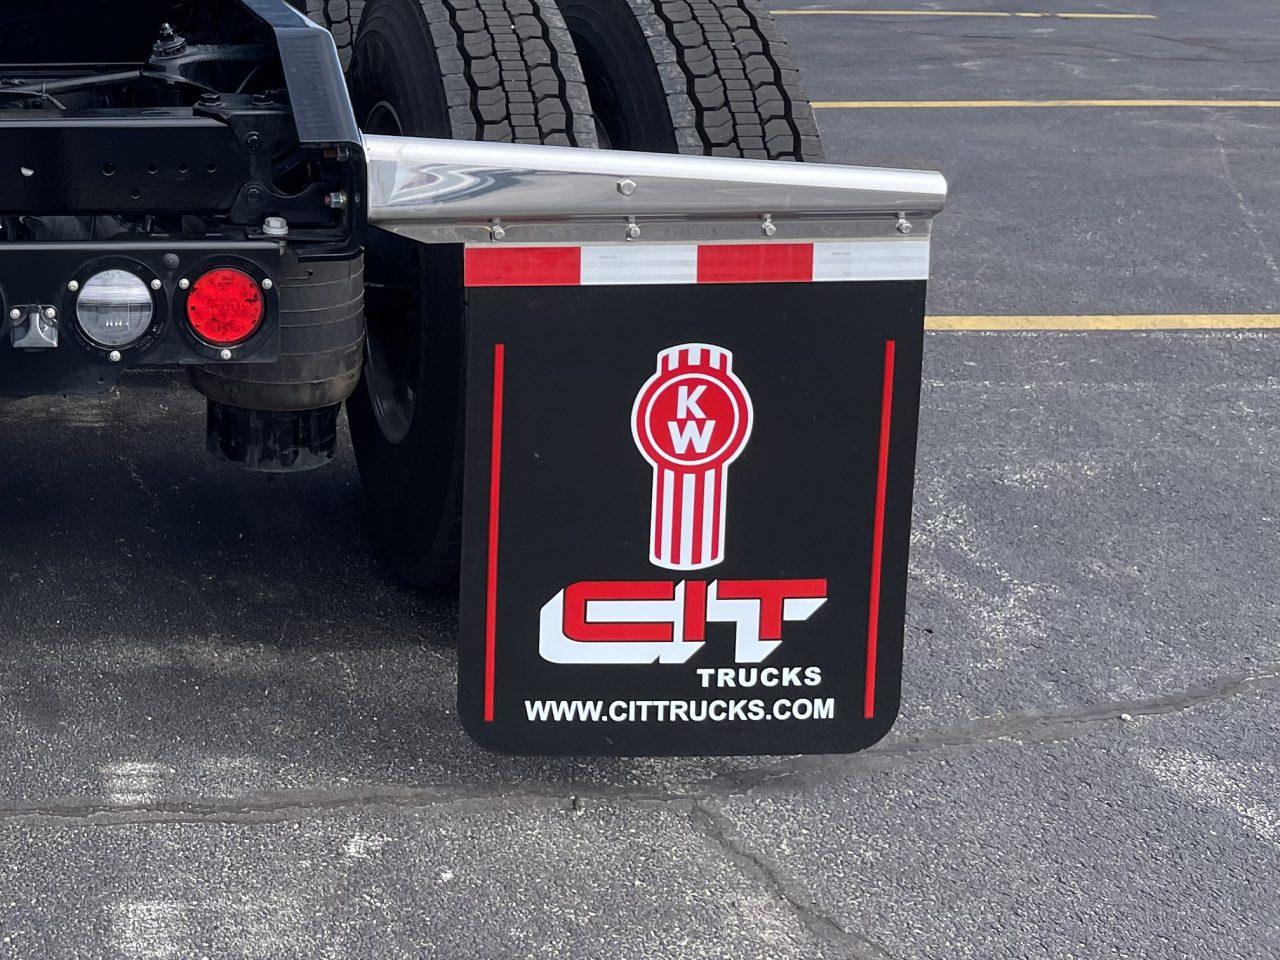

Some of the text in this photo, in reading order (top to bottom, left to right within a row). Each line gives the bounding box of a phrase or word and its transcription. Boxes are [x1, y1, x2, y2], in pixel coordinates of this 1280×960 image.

[677, 385, 708, 419] K
[667, 420, 716, 454] W
[539, 579, 827, 664] CIT
[697, 667, 822, 688] TRUCKS
[524, 698, 835, 722] WWW.CITTRUCKS.COM
